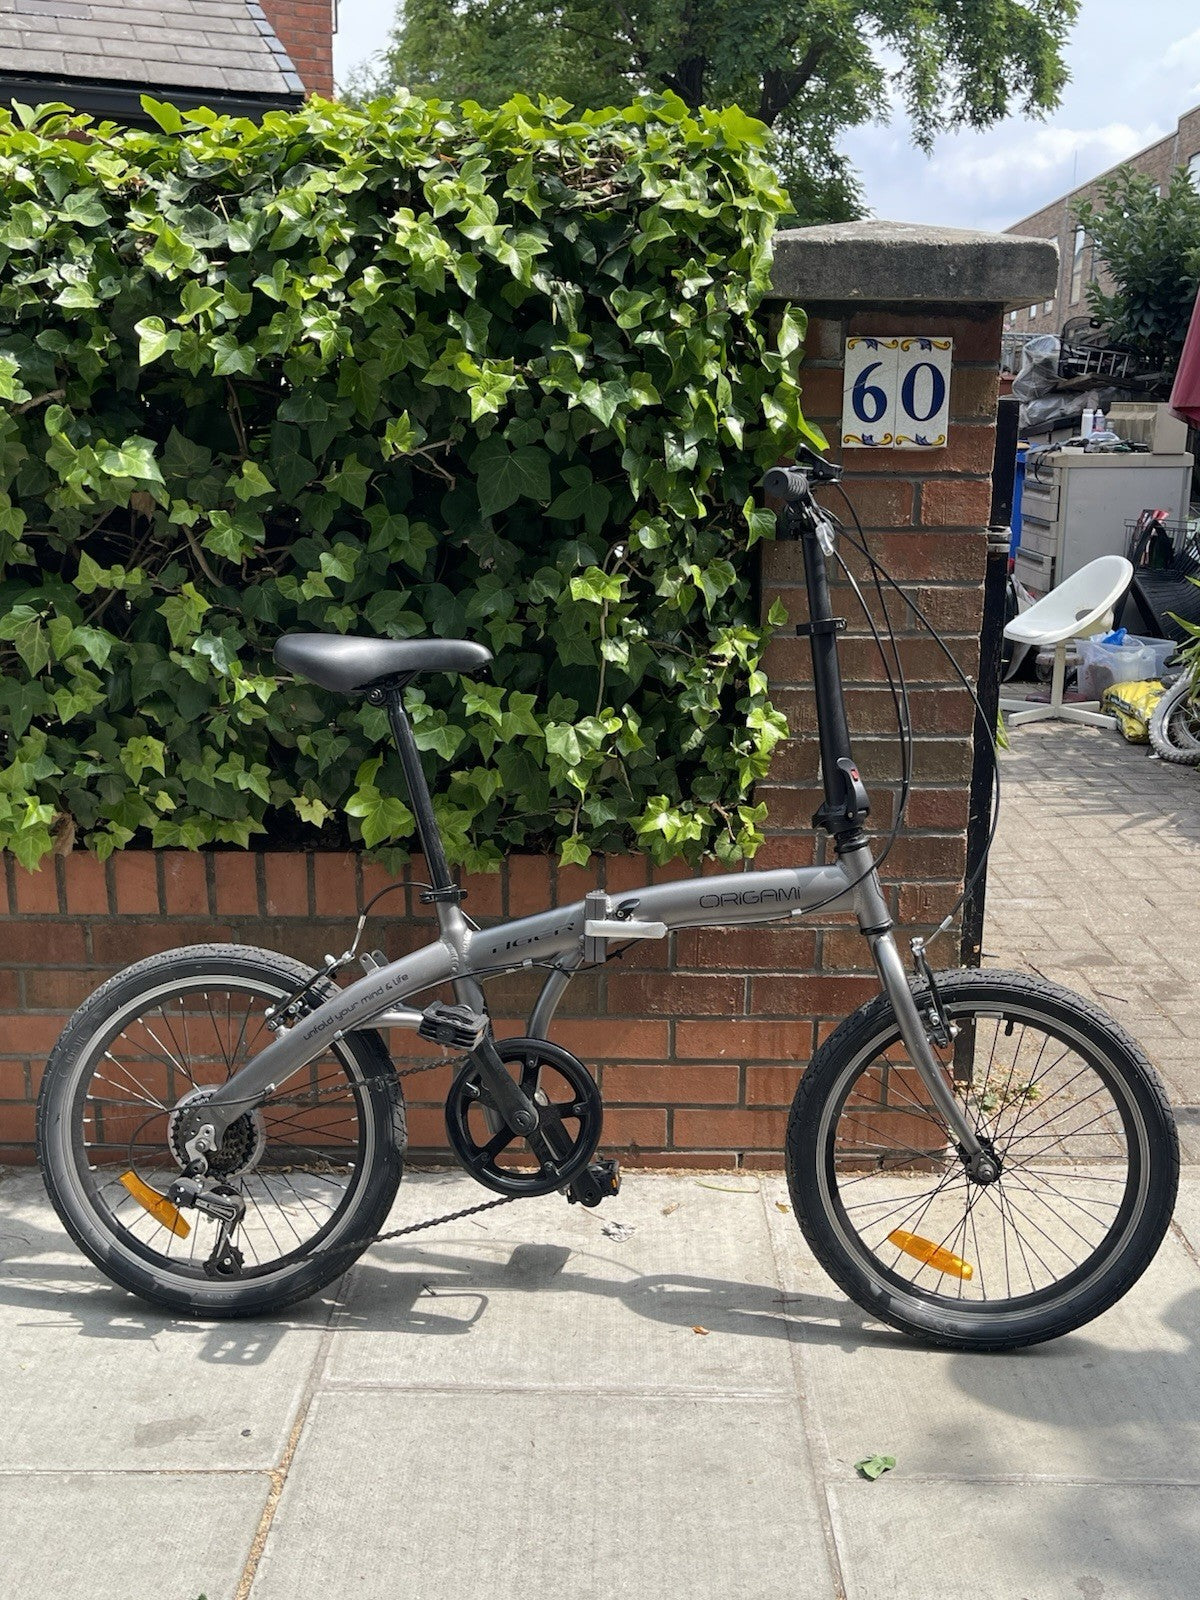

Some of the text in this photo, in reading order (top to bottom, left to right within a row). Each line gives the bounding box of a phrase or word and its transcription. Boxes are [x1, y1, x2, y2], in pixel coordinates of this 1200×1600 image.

[852, 362, 946, 423] 60
[303, 1016, 335, 1040] unfold
[335, 1001, 359, 1020] your
[361, 987, 384, 1004] mind
[393, 973, 409, 986] life
